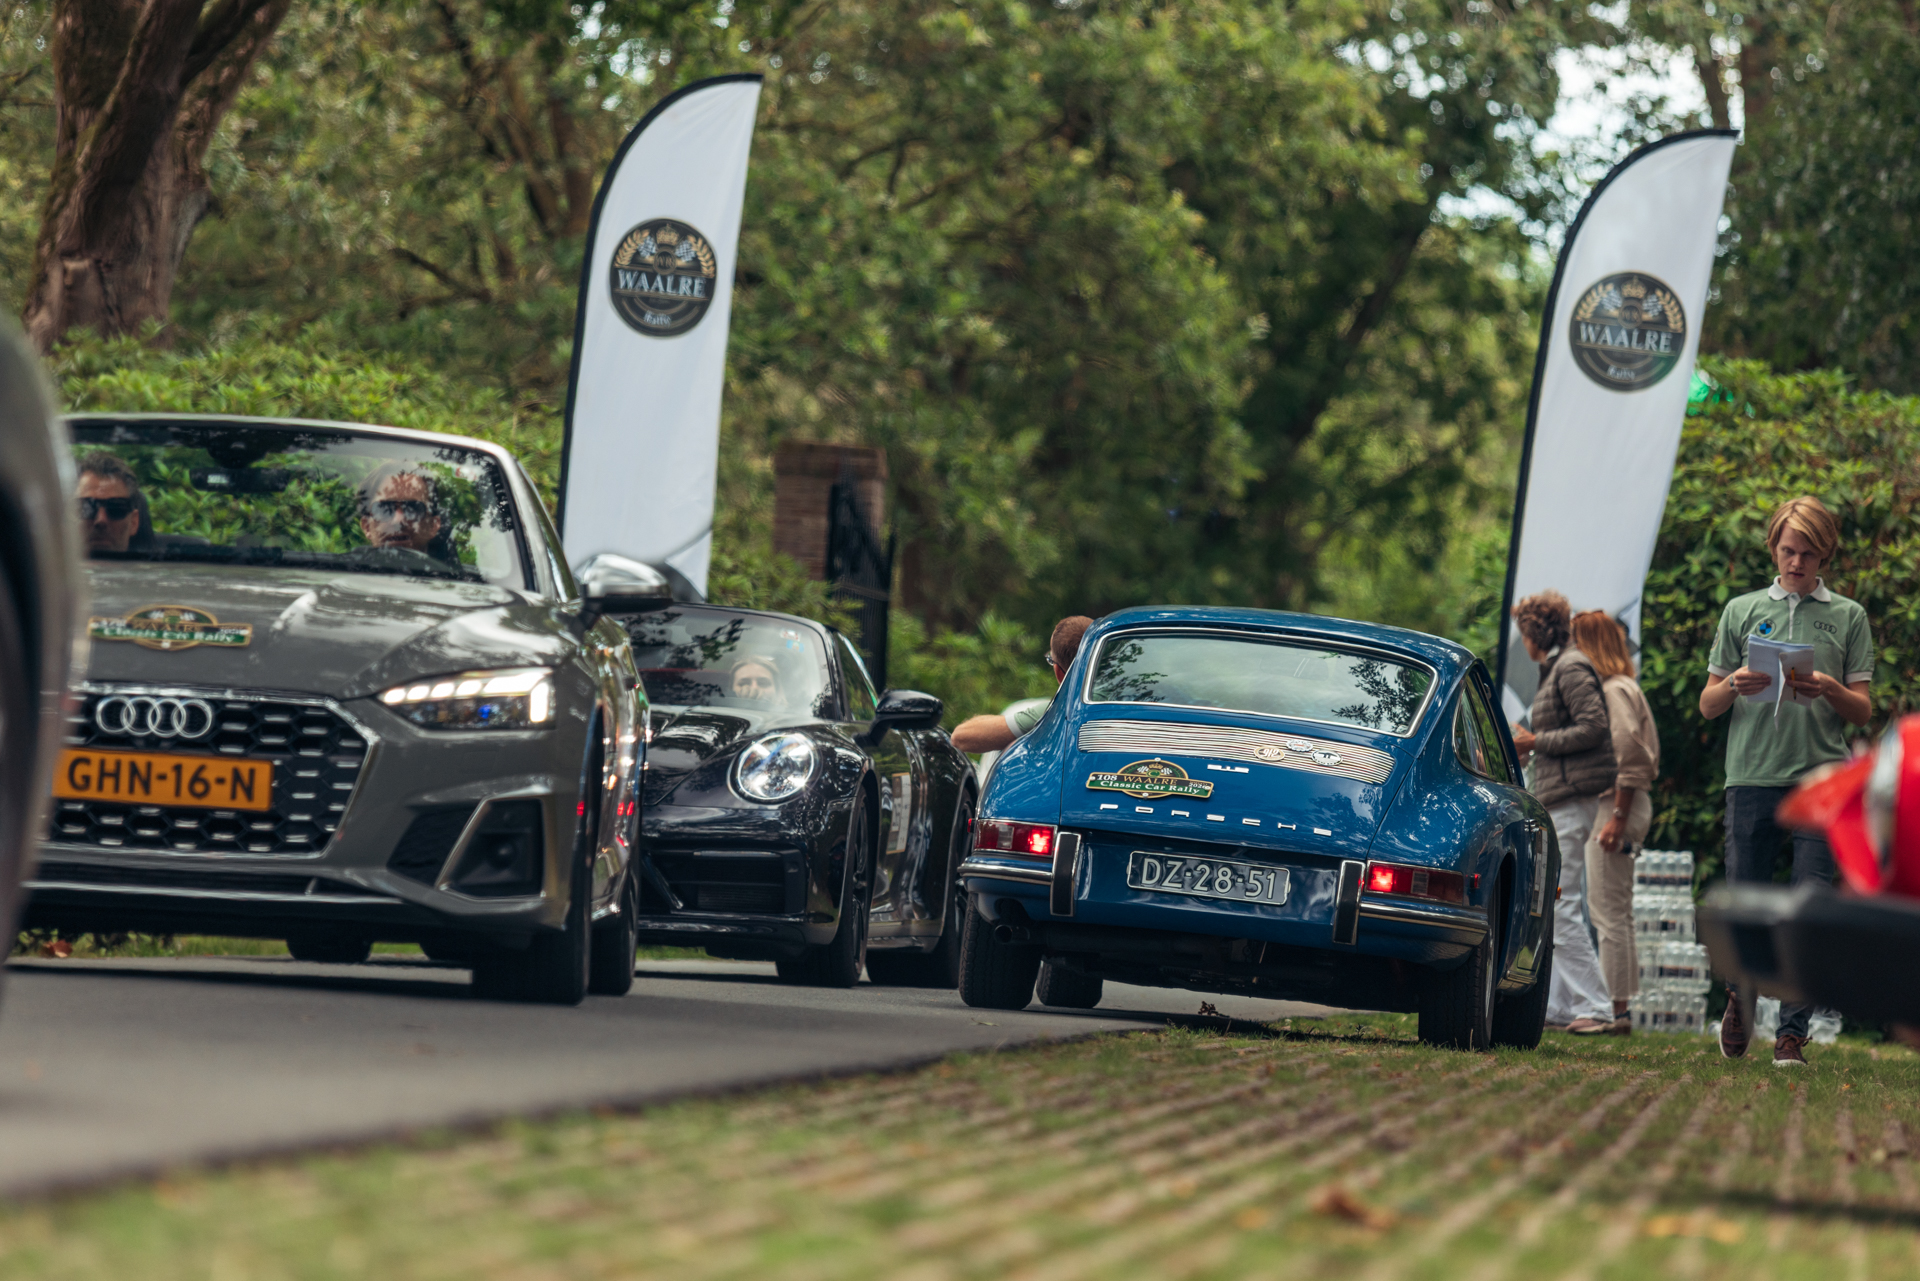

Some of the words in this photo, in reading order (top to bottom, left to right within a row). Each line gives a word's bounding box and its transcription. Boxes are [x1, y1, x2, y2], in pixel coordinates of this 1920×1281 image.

[617, 269, 706, 298] WAALRE
[1579, 321, 1673, 353] WAALRE
[67, 757, 256, 803] GHN-16-N
[1100, 780, 1141, 790] Classic
[1144, 783, 1166, 791] Car
[1168, 785, 1200, 795] Rally
[1123, 775, 1178, 786] WAALRE
[1100, 803, 1332, 837] PORSCHE
[1141, 858, 1276, 899] DZ-28-51
